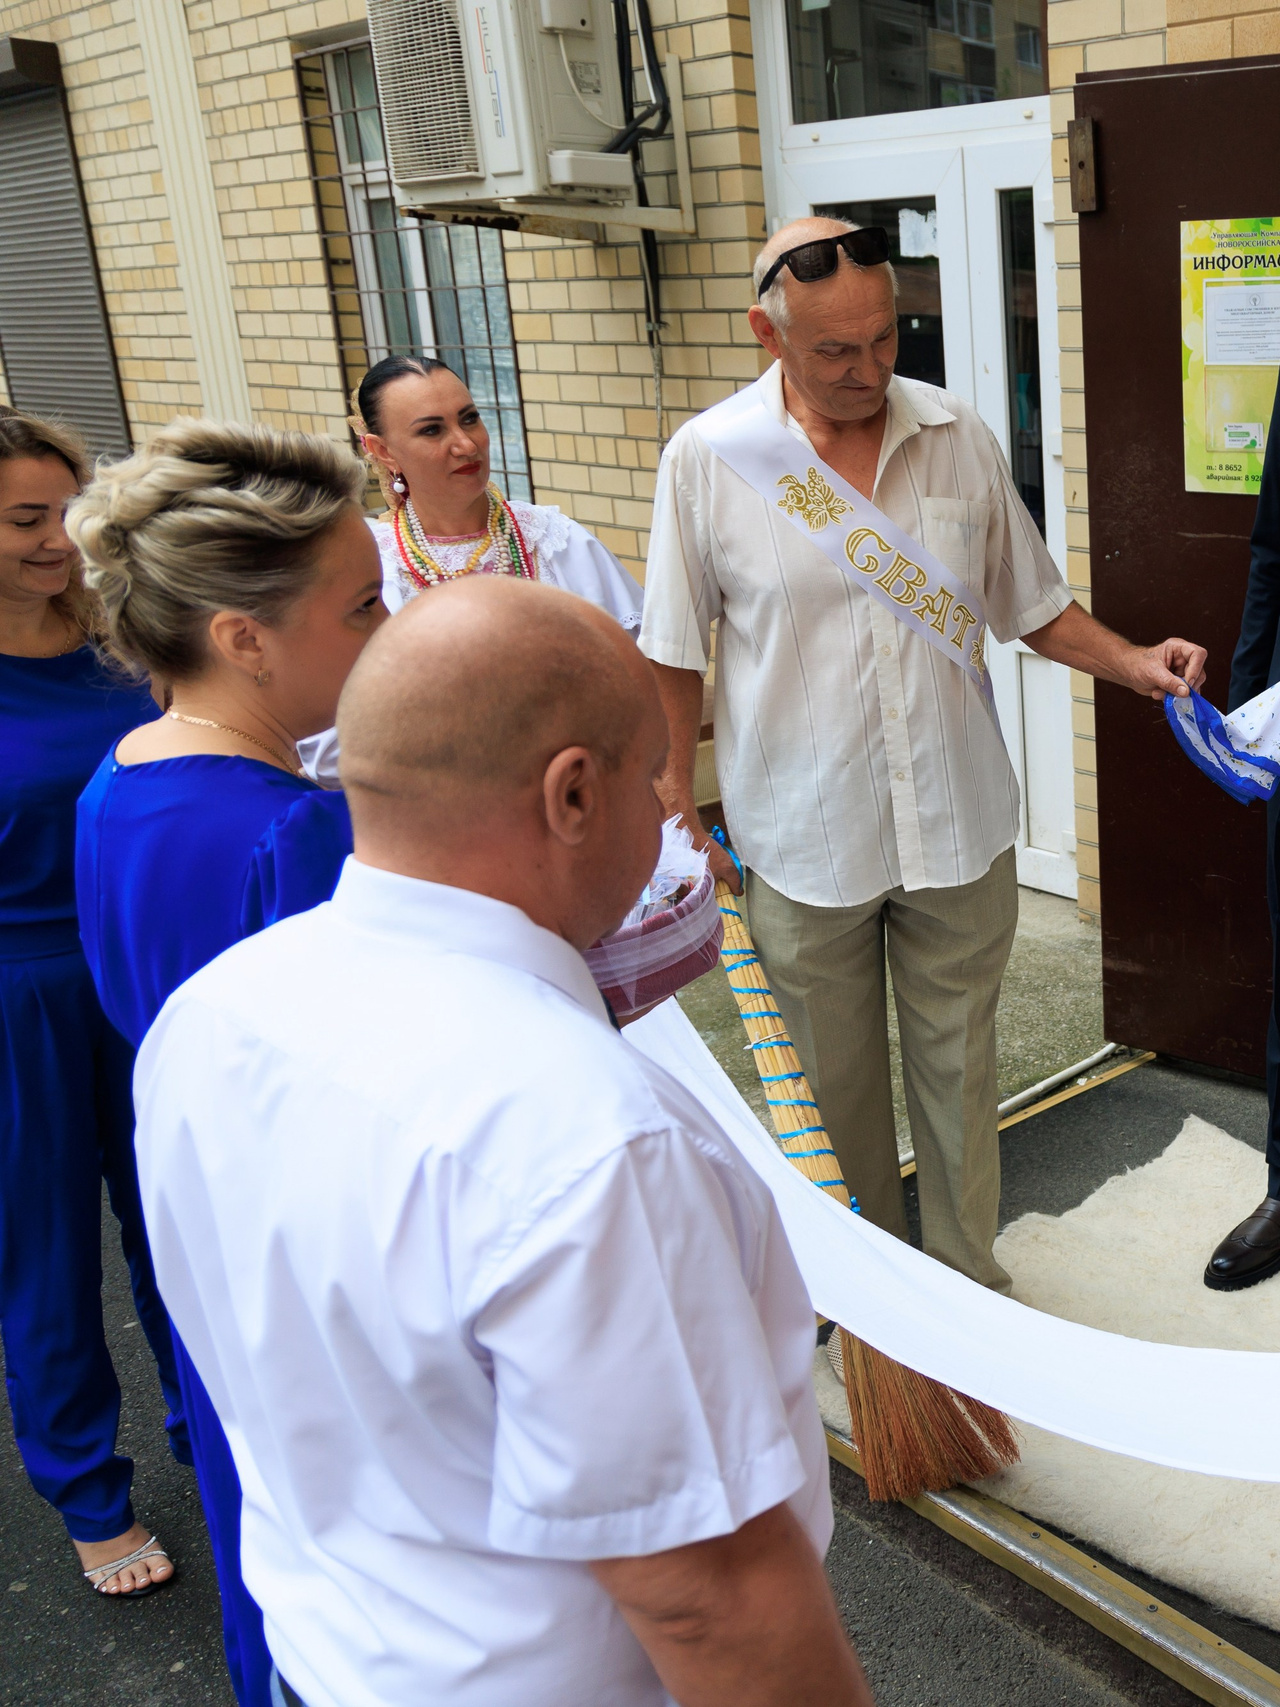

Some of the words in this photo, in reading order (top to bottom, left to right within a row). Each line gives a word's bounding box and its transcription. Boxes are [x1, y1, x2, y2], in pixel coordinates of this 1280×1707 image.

[1218, 463, 1223, 471] 8
[1225, 464, 1242, 472] 8652
[1206, 473, 1243, 481] аварийная:
[1244, 474, 1250, 482] 8
[843, 526, 979, 652] СВАТ
